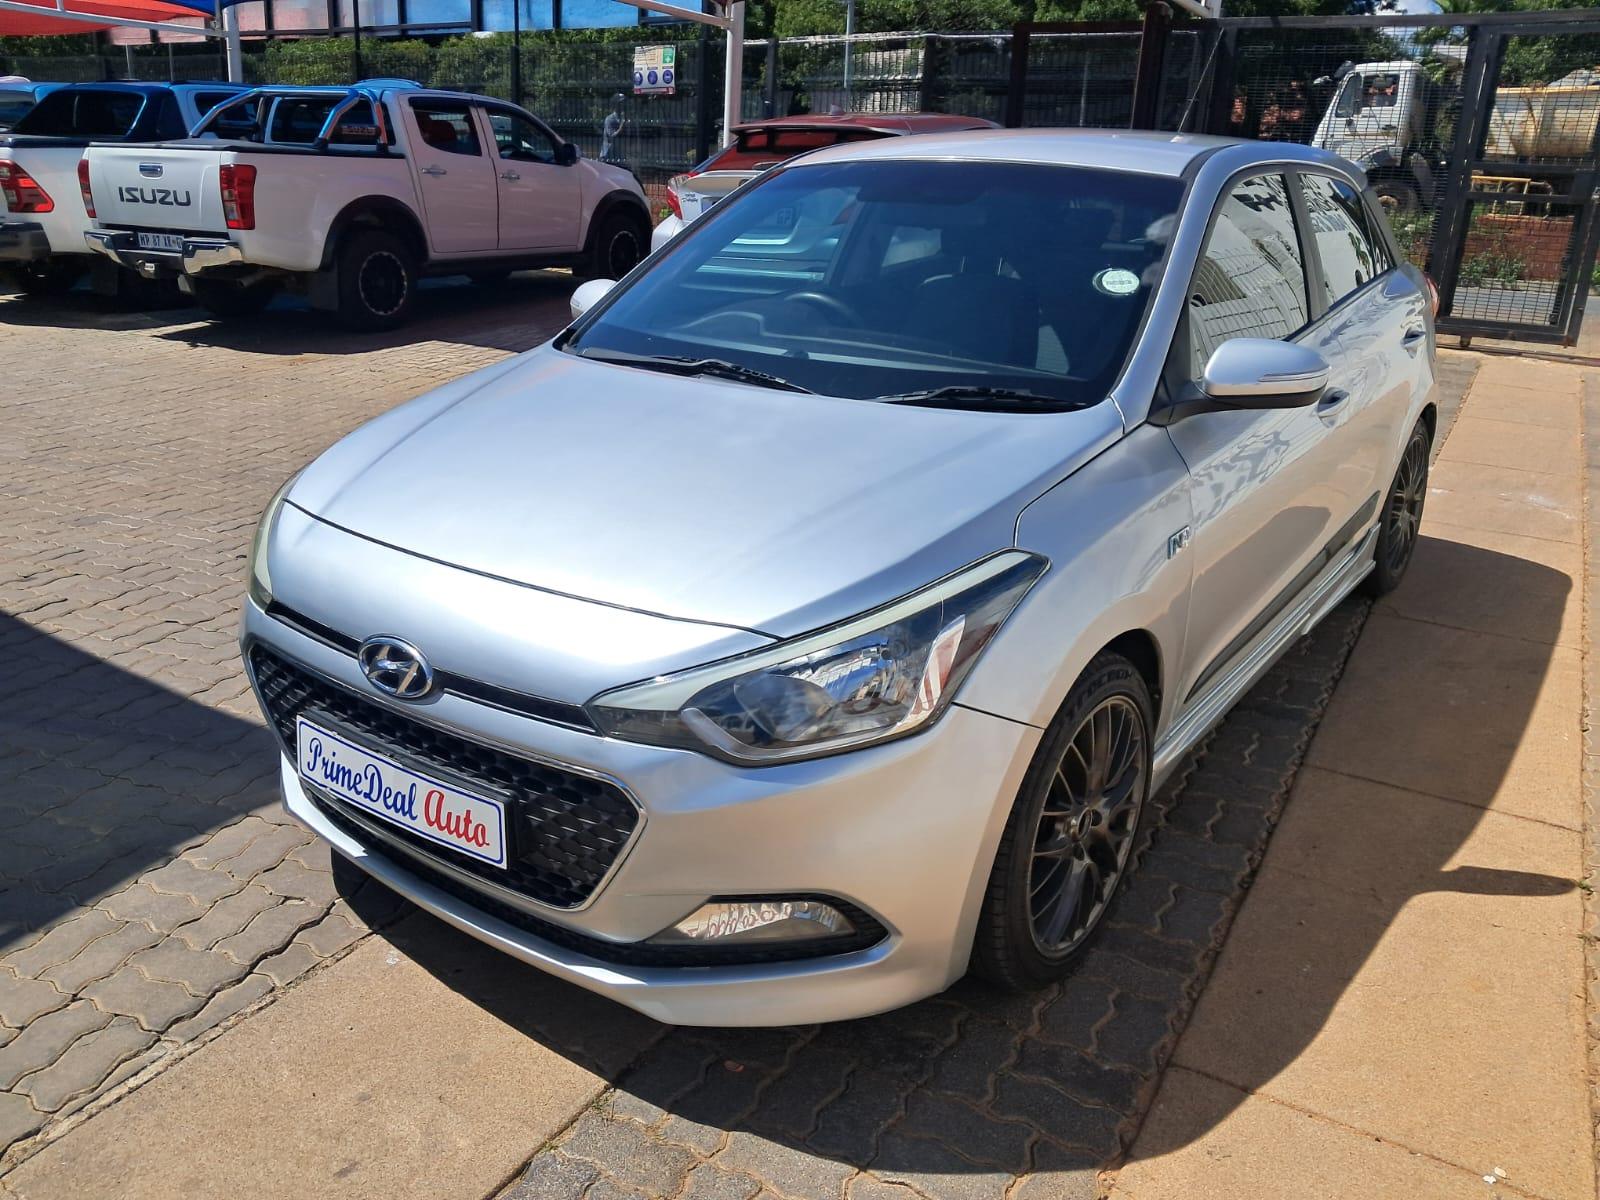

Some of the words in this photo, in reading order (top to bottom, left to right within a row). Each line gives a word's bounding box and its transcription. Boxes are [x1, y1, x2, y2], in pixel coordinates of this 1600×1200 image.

[118, 186, 192, 206] ISUZU
[306, 737, 418, 821] PrimeDeal
[423, 789, 490, 848] Auto
